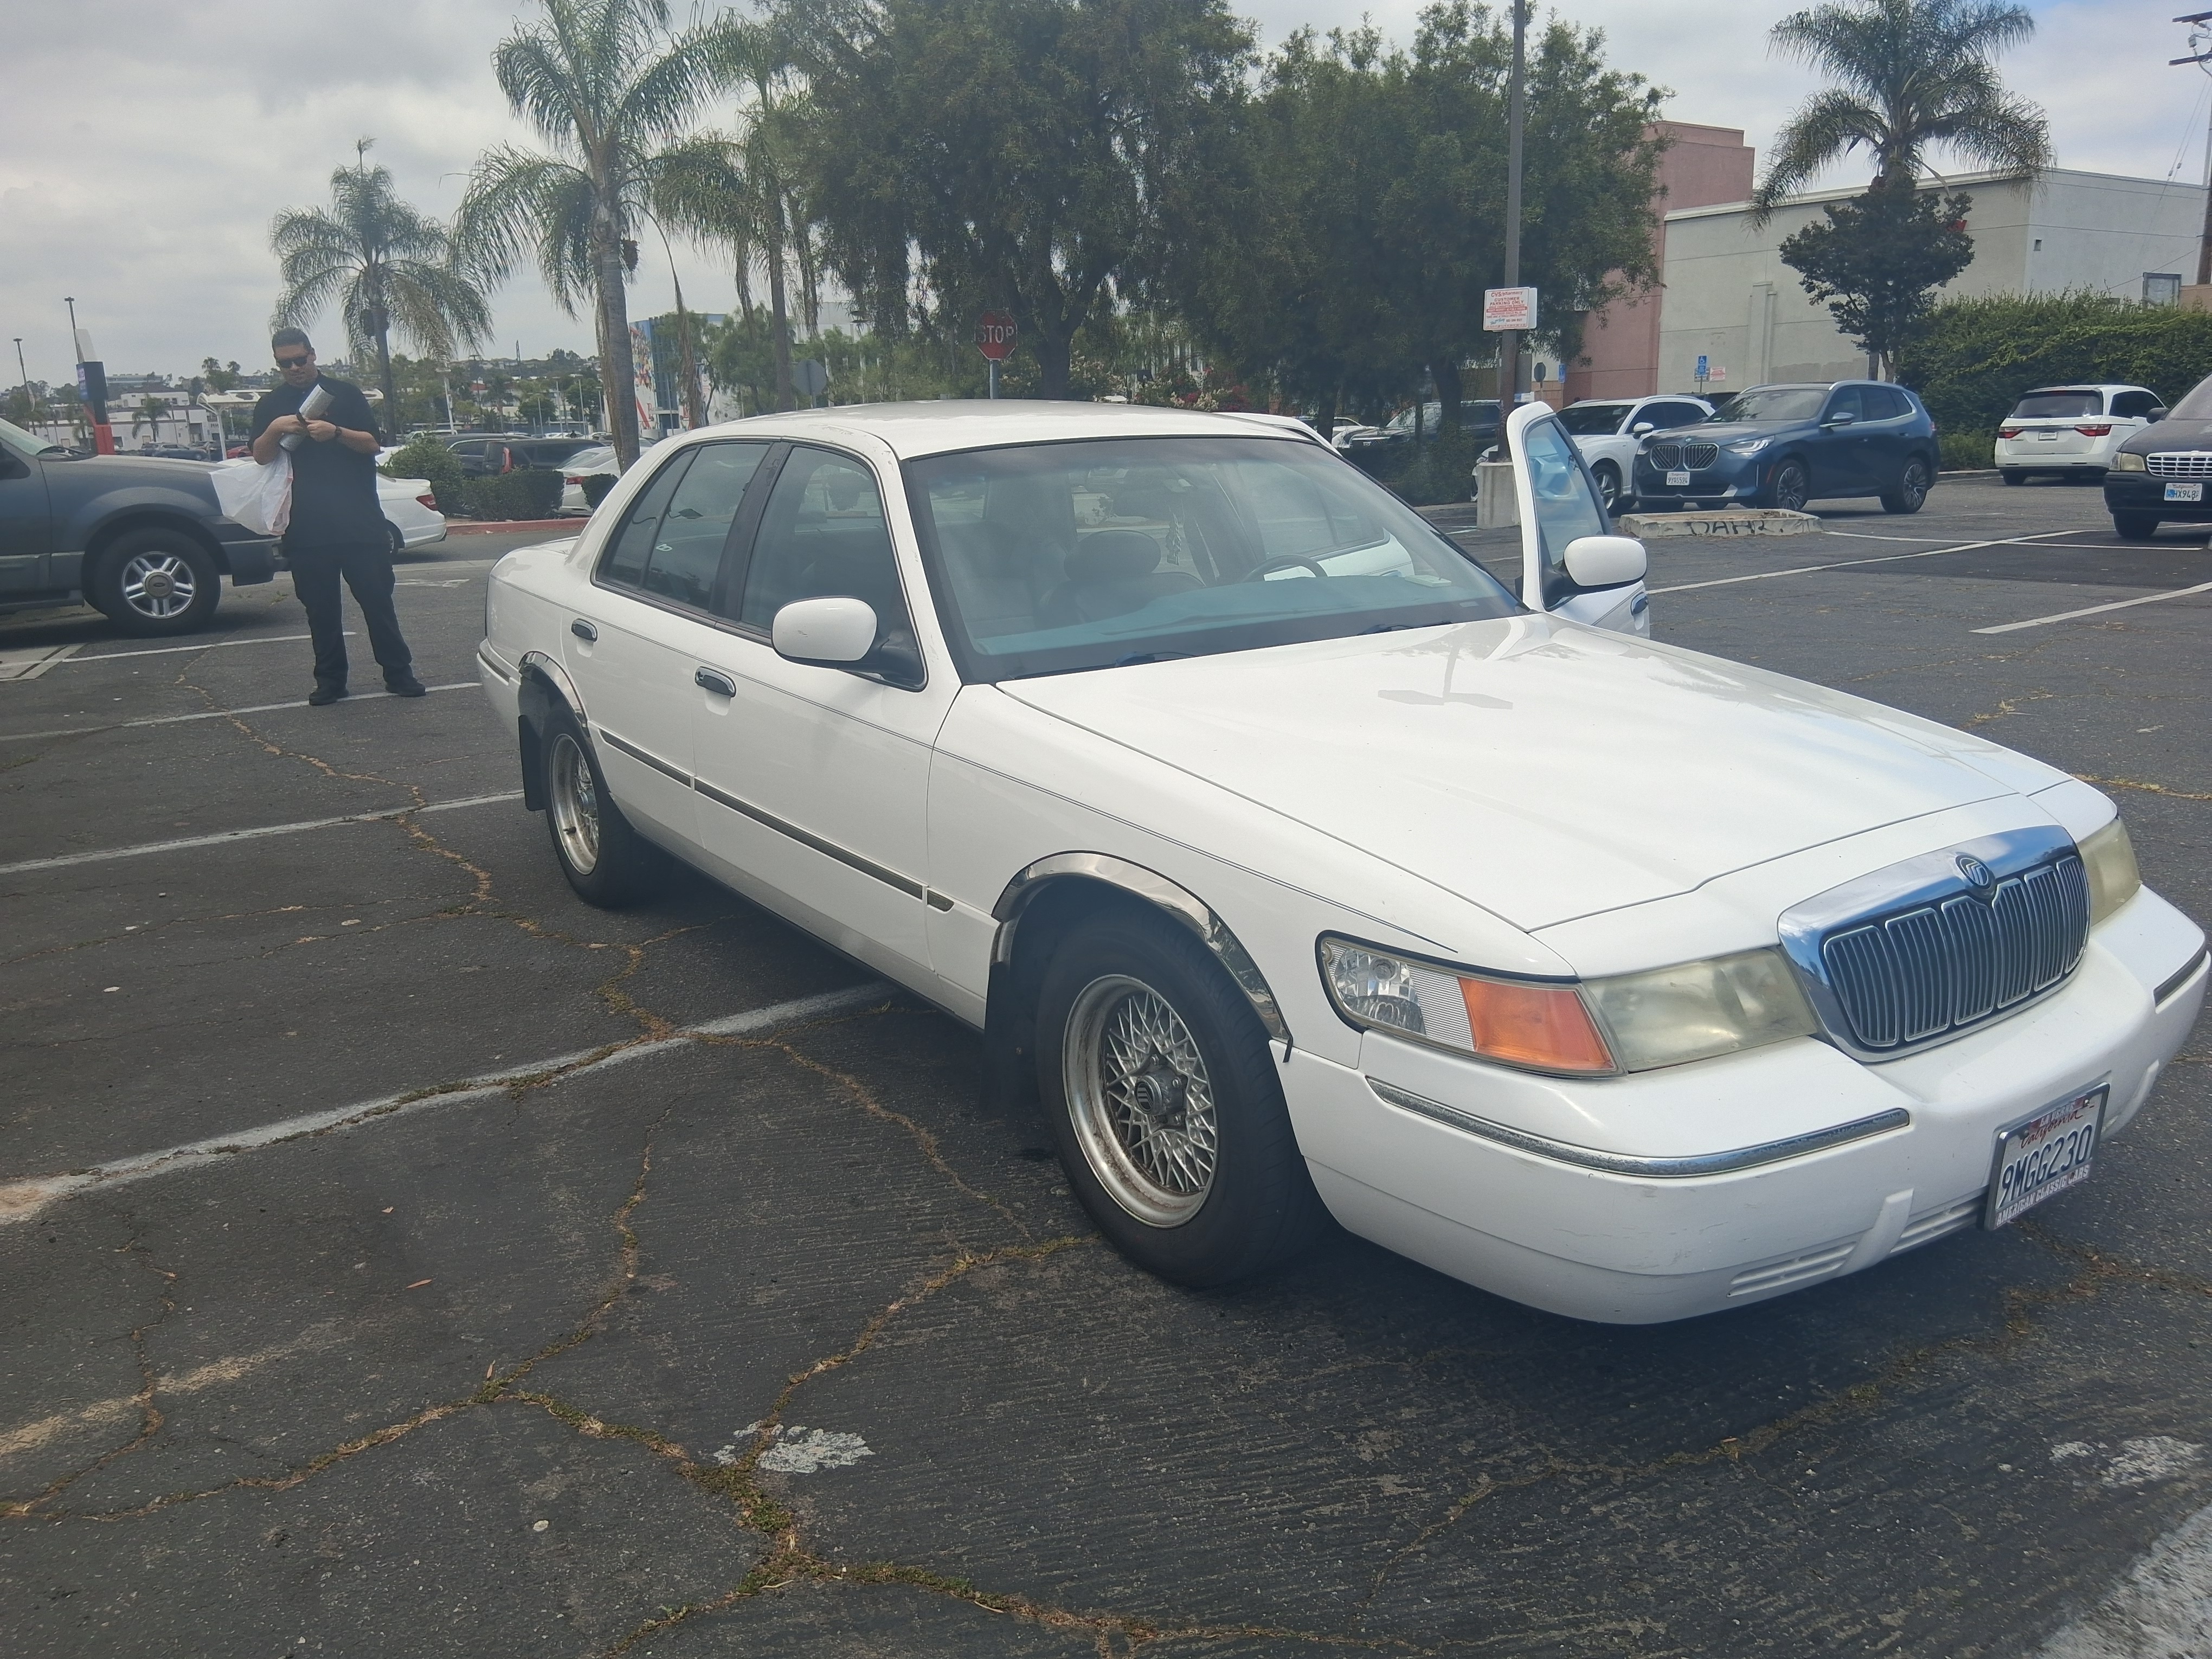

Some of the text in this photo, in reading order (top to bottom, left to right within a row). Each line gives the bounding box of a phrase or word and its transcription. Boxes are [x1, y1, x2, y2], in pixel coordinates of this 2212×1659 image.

[2021, 1110, 2084, 1149] California
[1996, 1124, 2093, 1210] 9MGG230
[1996, 1164, 2091, 1226] AMERICAN CLASSIC CARS
